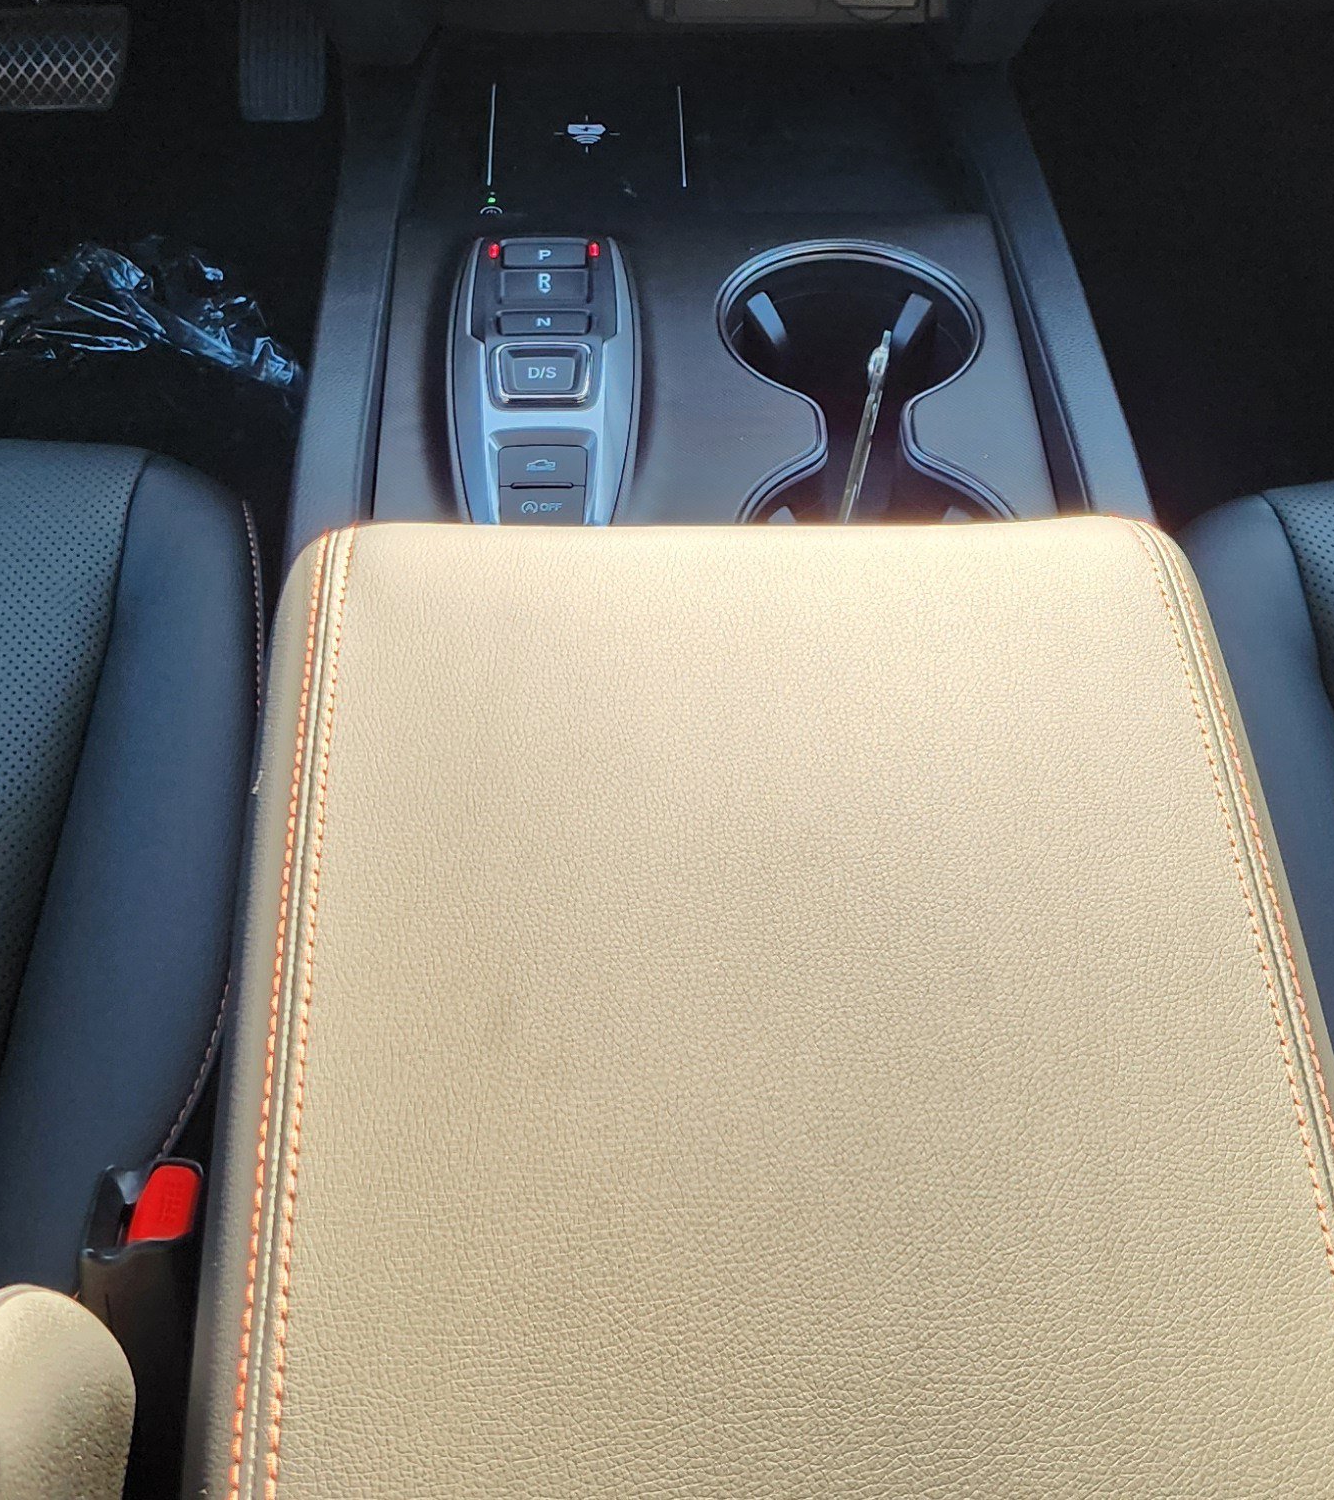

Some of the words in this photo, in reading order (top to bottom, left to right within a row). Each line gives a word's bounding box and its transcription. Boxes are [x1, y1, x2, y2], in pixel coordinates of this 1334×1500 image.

[538, 250, 551, 260] P
[538, 273, 551, 288] R
[536, 317, 551, 327] N
[528, 367, 557, 379] D/S
[540, 502, 563, 512] OFF
